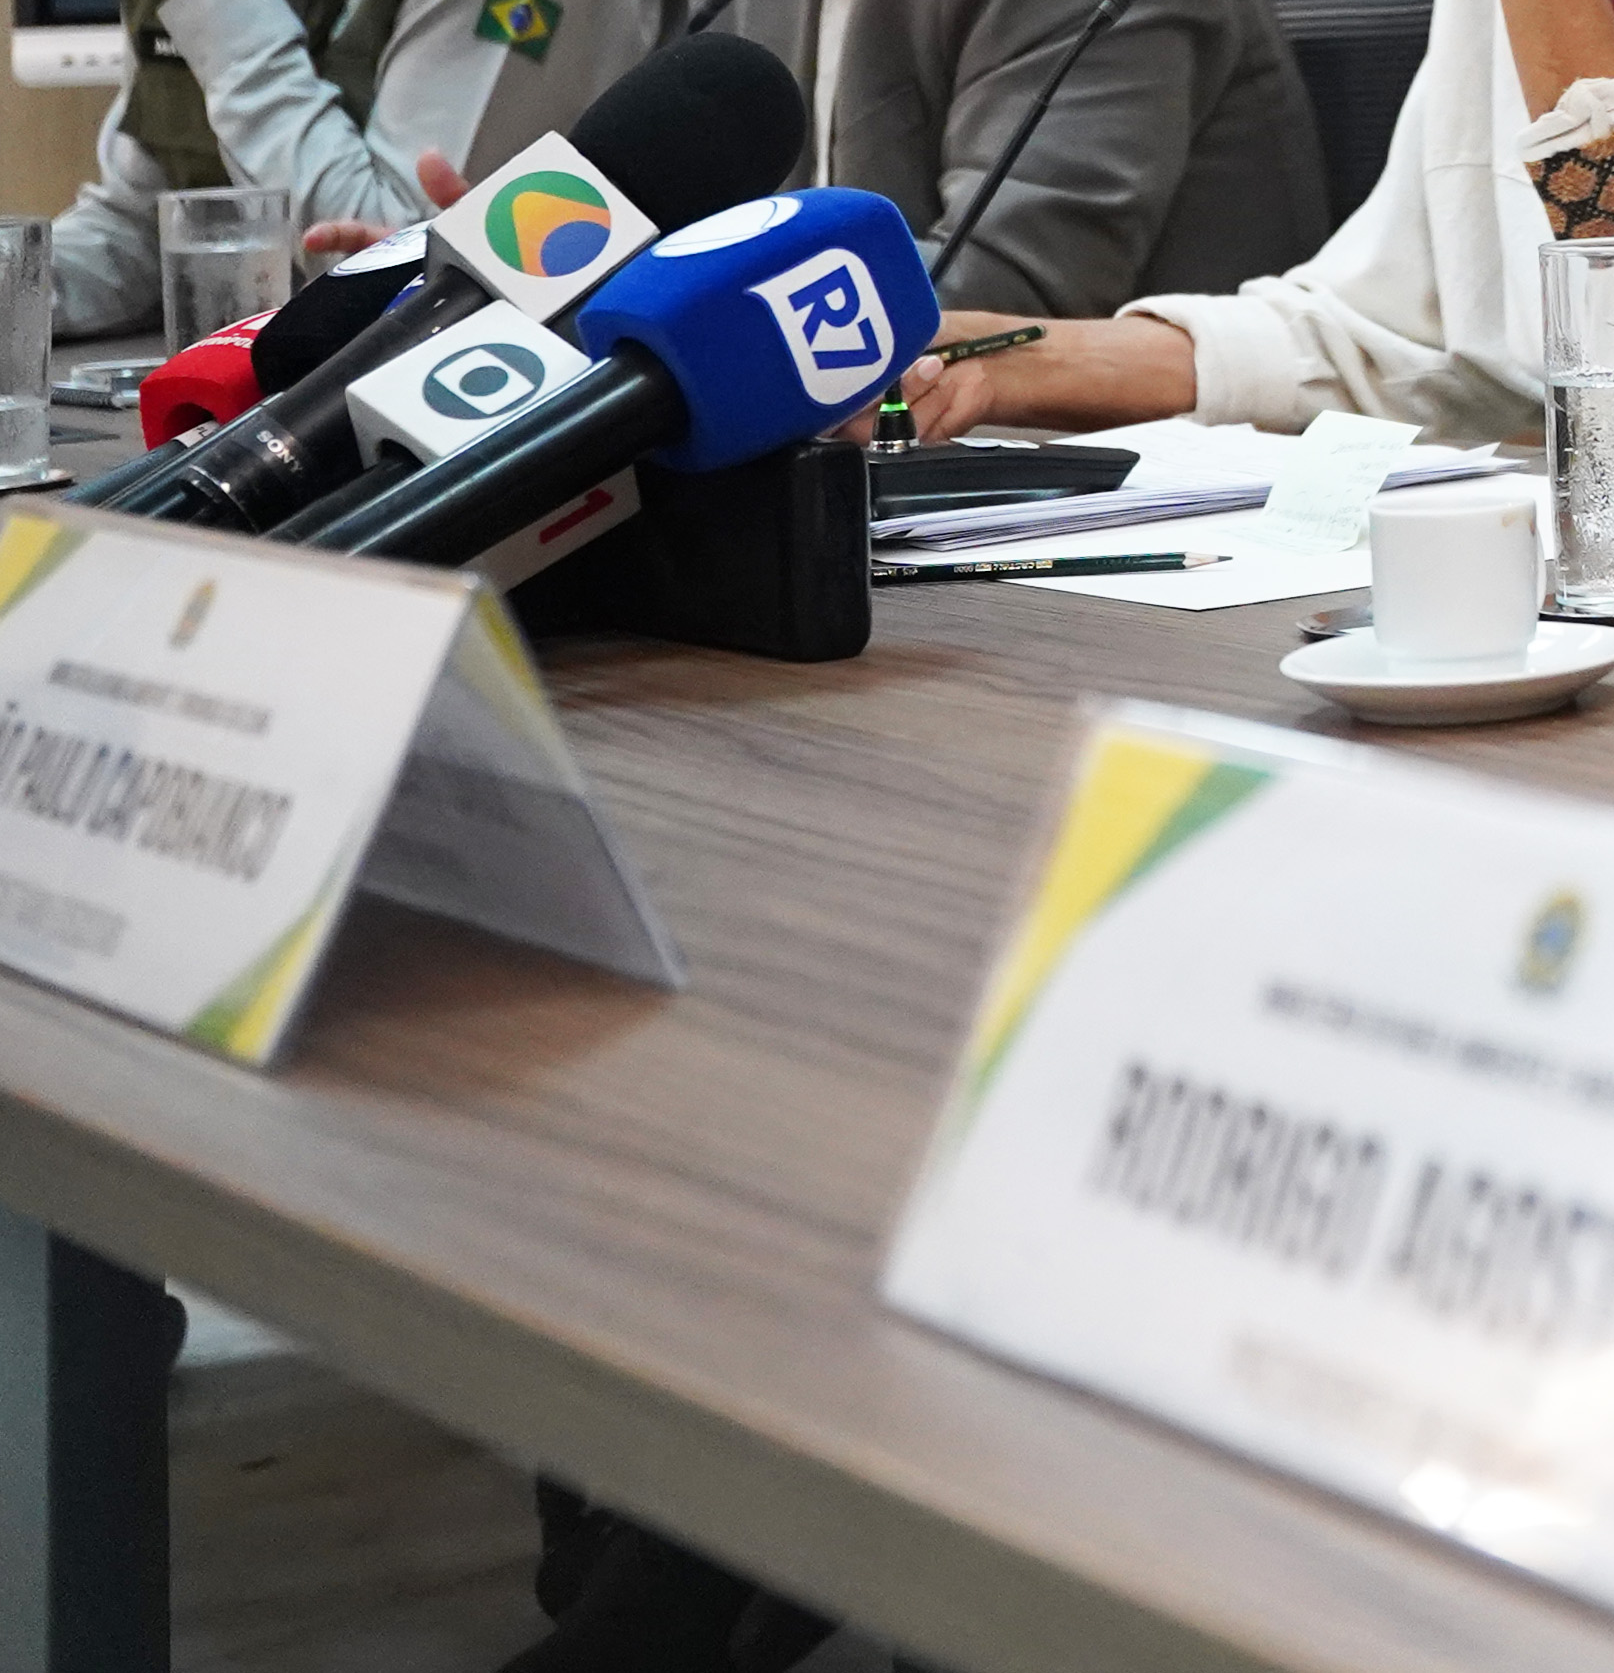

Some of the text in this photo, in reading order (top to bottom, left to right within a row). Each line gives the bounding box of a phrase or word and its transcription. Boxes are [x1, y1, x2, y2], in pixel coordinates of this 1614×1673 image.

[787, 265, 882, 371] R7
[255, 429, 303, 473] SONY
[1090, 1060, 1386, 1281] RODRIGO
